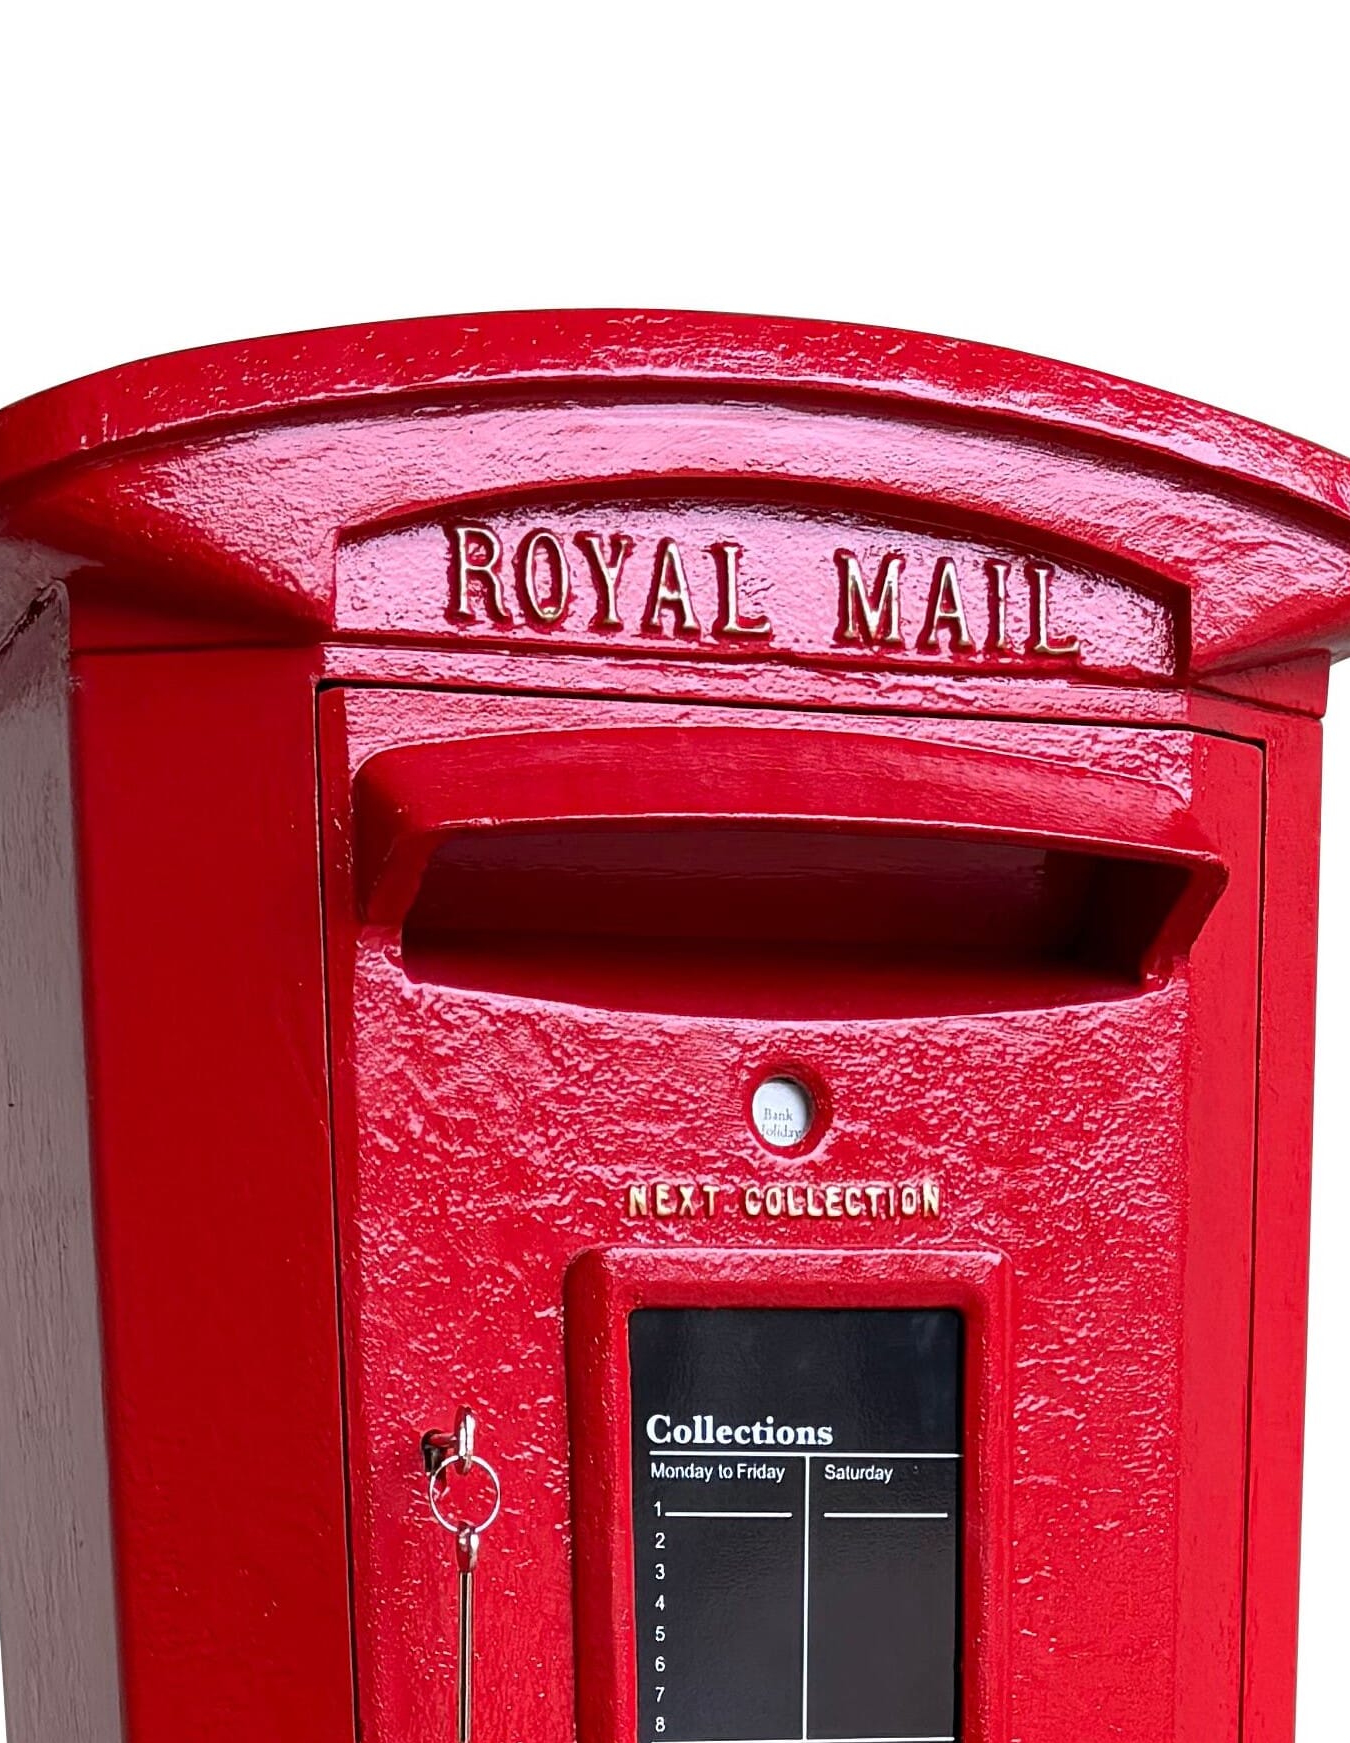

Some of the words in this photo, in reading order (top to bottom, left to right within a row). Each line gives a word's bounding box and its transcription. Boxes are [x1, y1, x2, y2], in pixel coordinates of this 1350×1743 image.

[452, 524, 773, 638] ROYAL
[836, 550, 1083, 656] MAIL
[764, 1107, 793, 1121] Bank
[628, 1183, 719, 1217] NEXT
[744, 1183, 941, 1218] COLLECTION
[646, 1413, 834, 1446] Collections
[650, 1461, 714, 1483] Monday
[718, 1463, 734, 1479] to
[736, 1462, 786, 1484] Friday
[824, 1463, 894, 1485] Saturday
[653, 1500, 662, 1517] 1
[654, 1532, 666, 1549] 2
[655, 1563, 666, 1580] 3
[654, 1594, 666, 1611] 4
[655, 1625, 666, 1642] 5
[655, 1655, 666, 1673] 6
[654, 1686, 666, 1703] 7
[655, 1716, 666, 1733] 8
